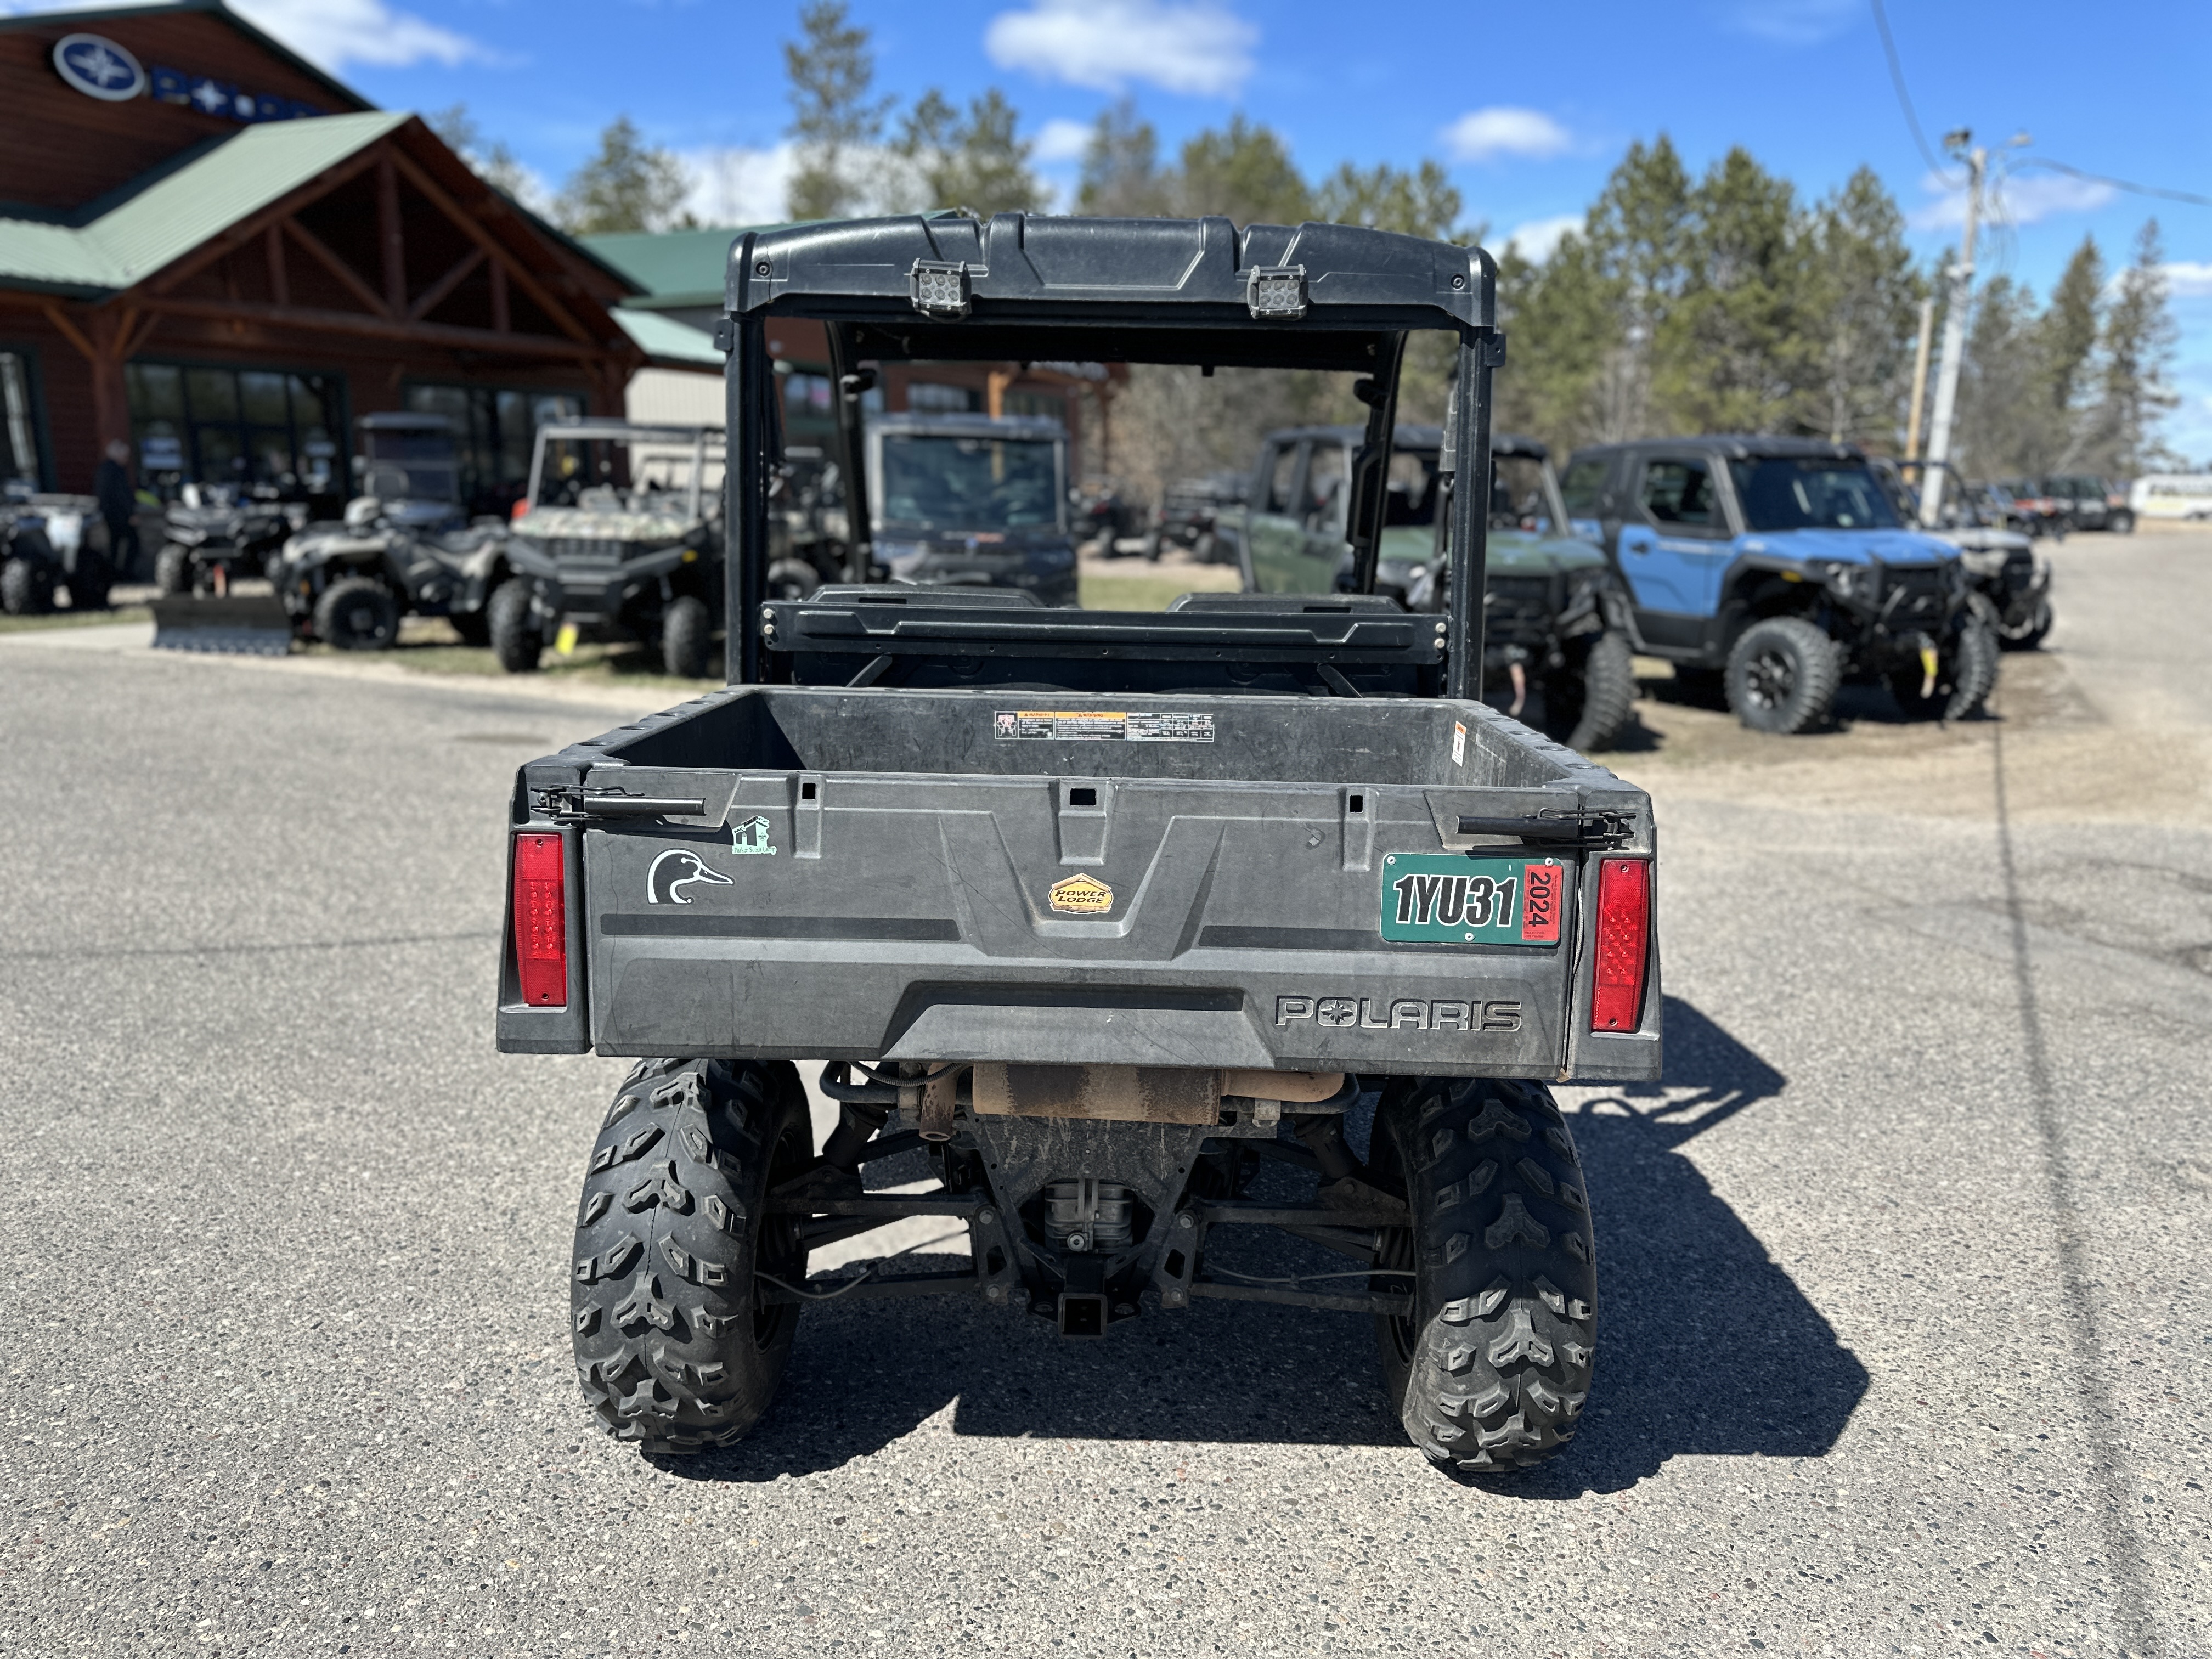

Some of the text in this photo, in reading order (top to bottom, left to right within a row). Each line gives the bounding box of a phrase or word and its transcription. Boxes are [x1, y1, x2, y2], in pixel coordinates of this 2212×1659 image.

[1393, 873, 1517, 928] 1YU31
[1528, 871, 1551, 927] 2024
[1275, 995, 1523, 1032] POLARIS
